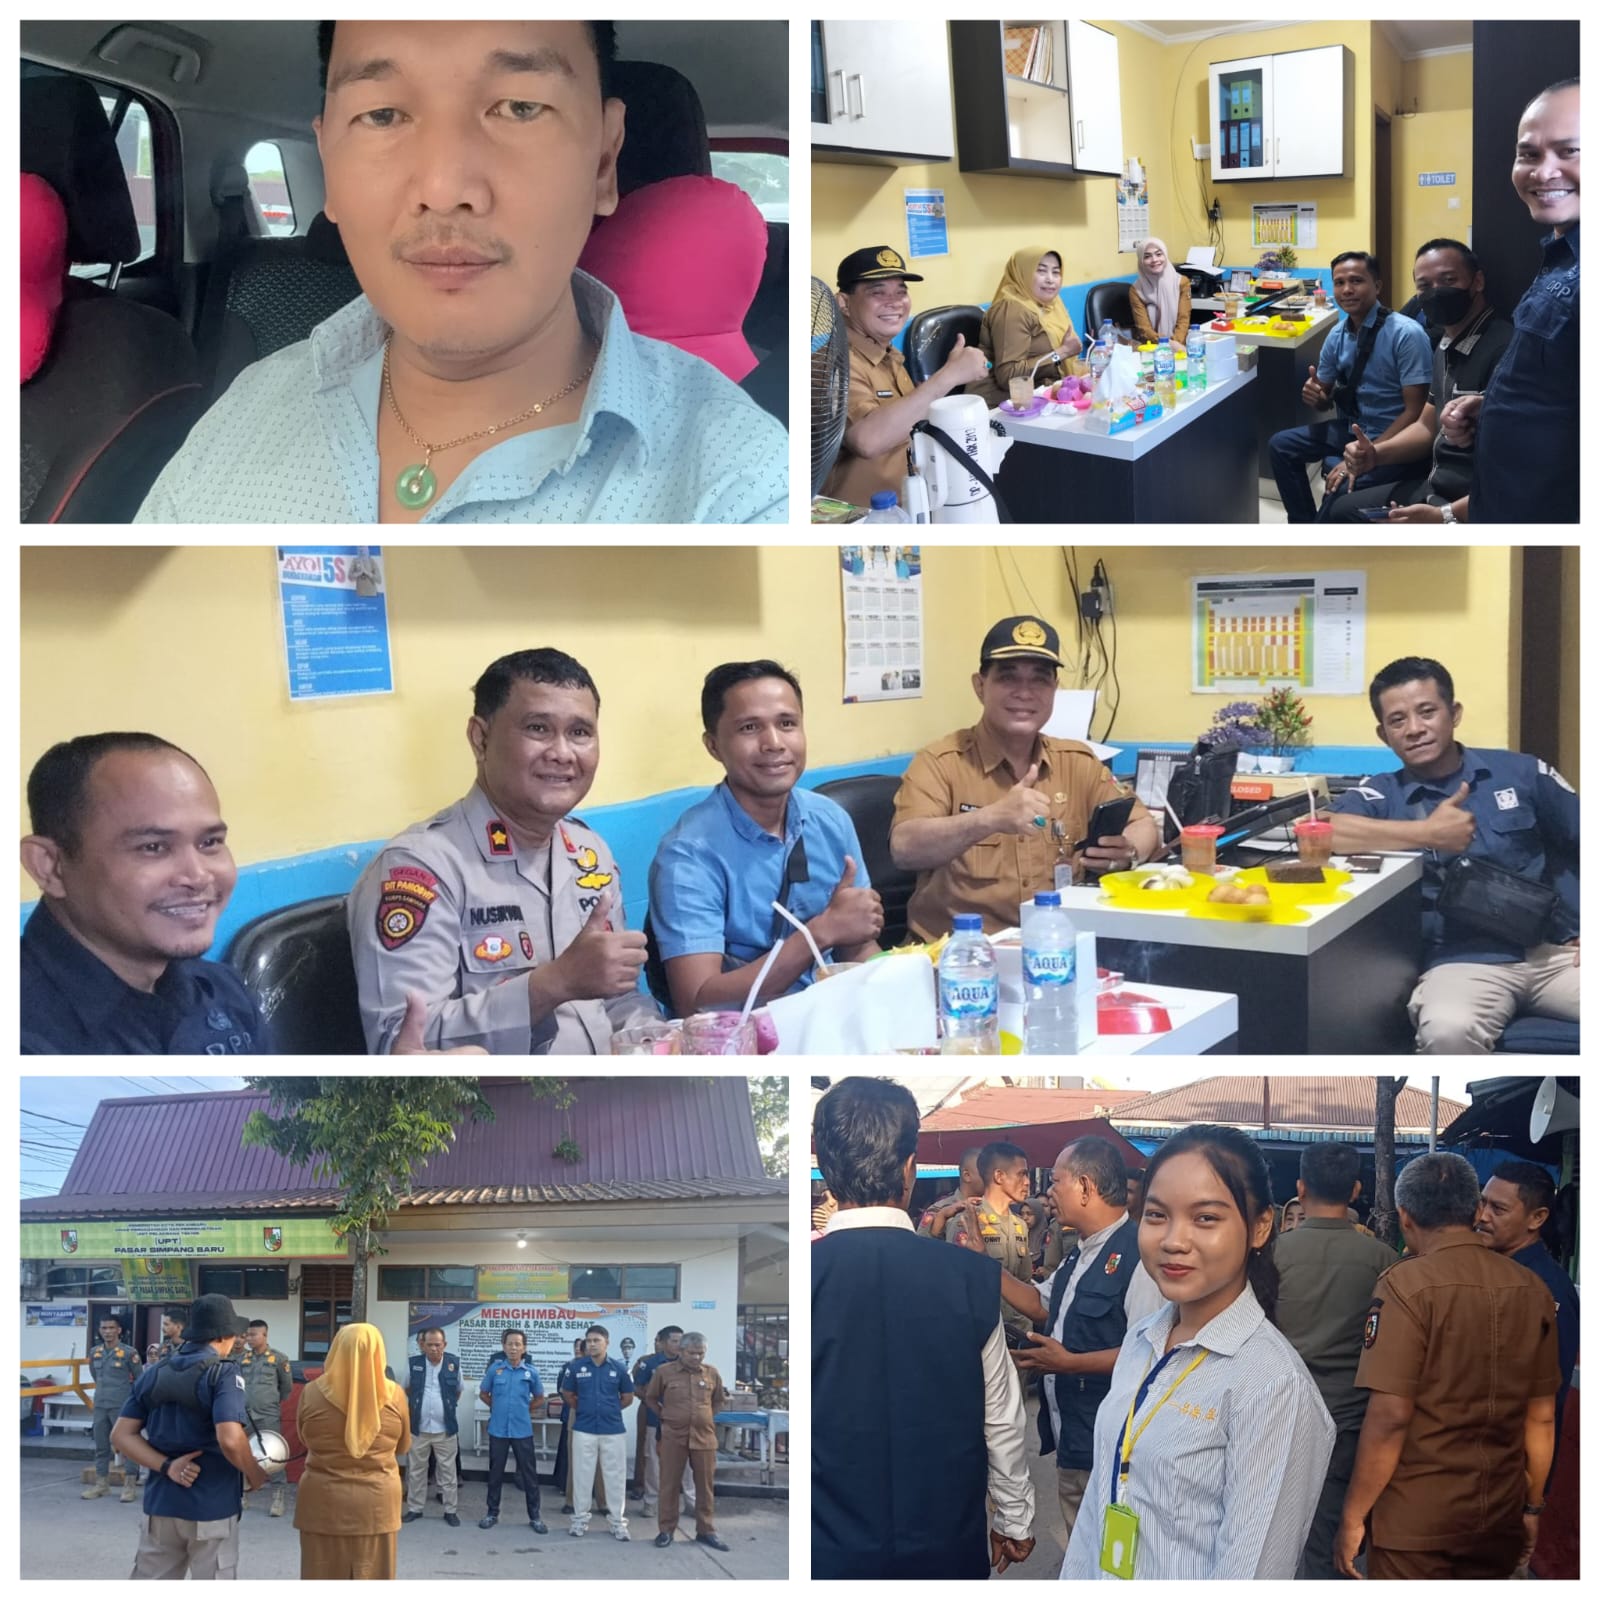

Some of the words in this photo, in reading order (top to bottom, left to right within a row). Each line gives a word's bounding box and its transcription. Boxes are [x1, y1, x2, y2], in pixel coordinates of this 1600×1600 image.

[1431, 174, 1455, 185] TOILET
[284, 556, 321, 572] AYO!
[323, 557, 346, 583] 5S
[578, 896, 601, 912] PO
[1032, 956, 1068, 971] AQUA
[952, 986, 989, 1002] AQUA
[155, 1237, 181, 1245] (UPT)
[481, 1308, 576, 1320] MENGHIMBAU
[459, 1320, 487, 1328] PASAR
[489, 1320, 521, 1329] BERSIH
[533, 1321, 562, 1329] PASAR
[565, 1321, 595, 1329] SEHAT
